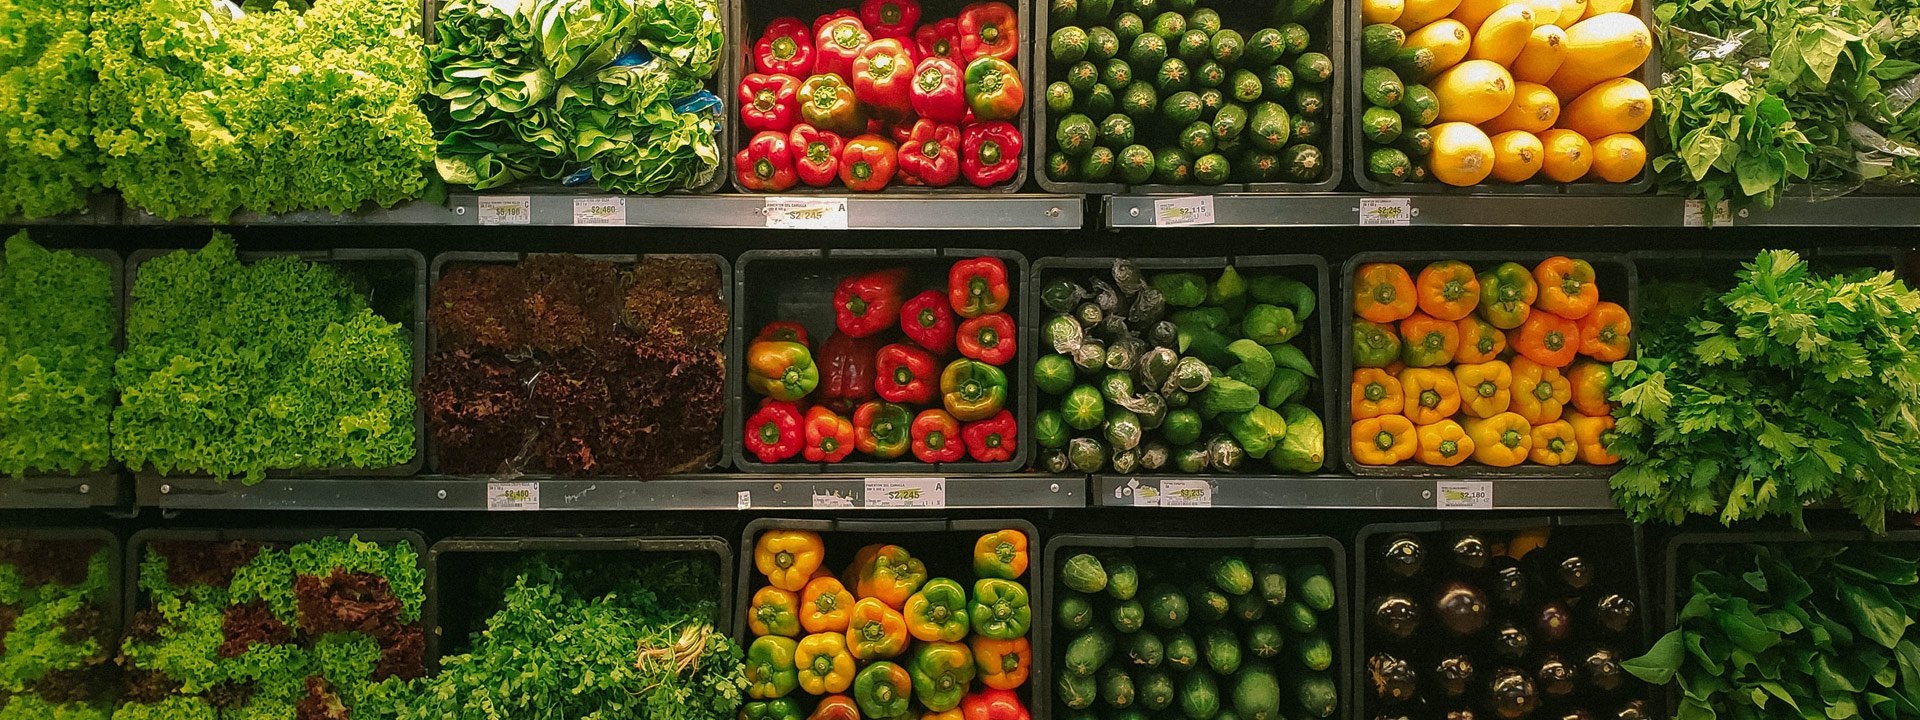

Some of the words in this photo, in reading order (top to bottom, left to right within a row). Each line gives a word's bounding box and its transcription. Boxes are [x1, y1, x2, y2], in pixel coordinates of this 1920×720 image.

[620, 198, 624, 206] C
[591, 206, 616, 214] $2,460
[838, 203, 845, 212] A
[1377, 206, 1402, 214] $2,245
[533, 482, 538, 490] C
[935, 483, 942, 491] A
[889, 491, 920, 500] $2,245
